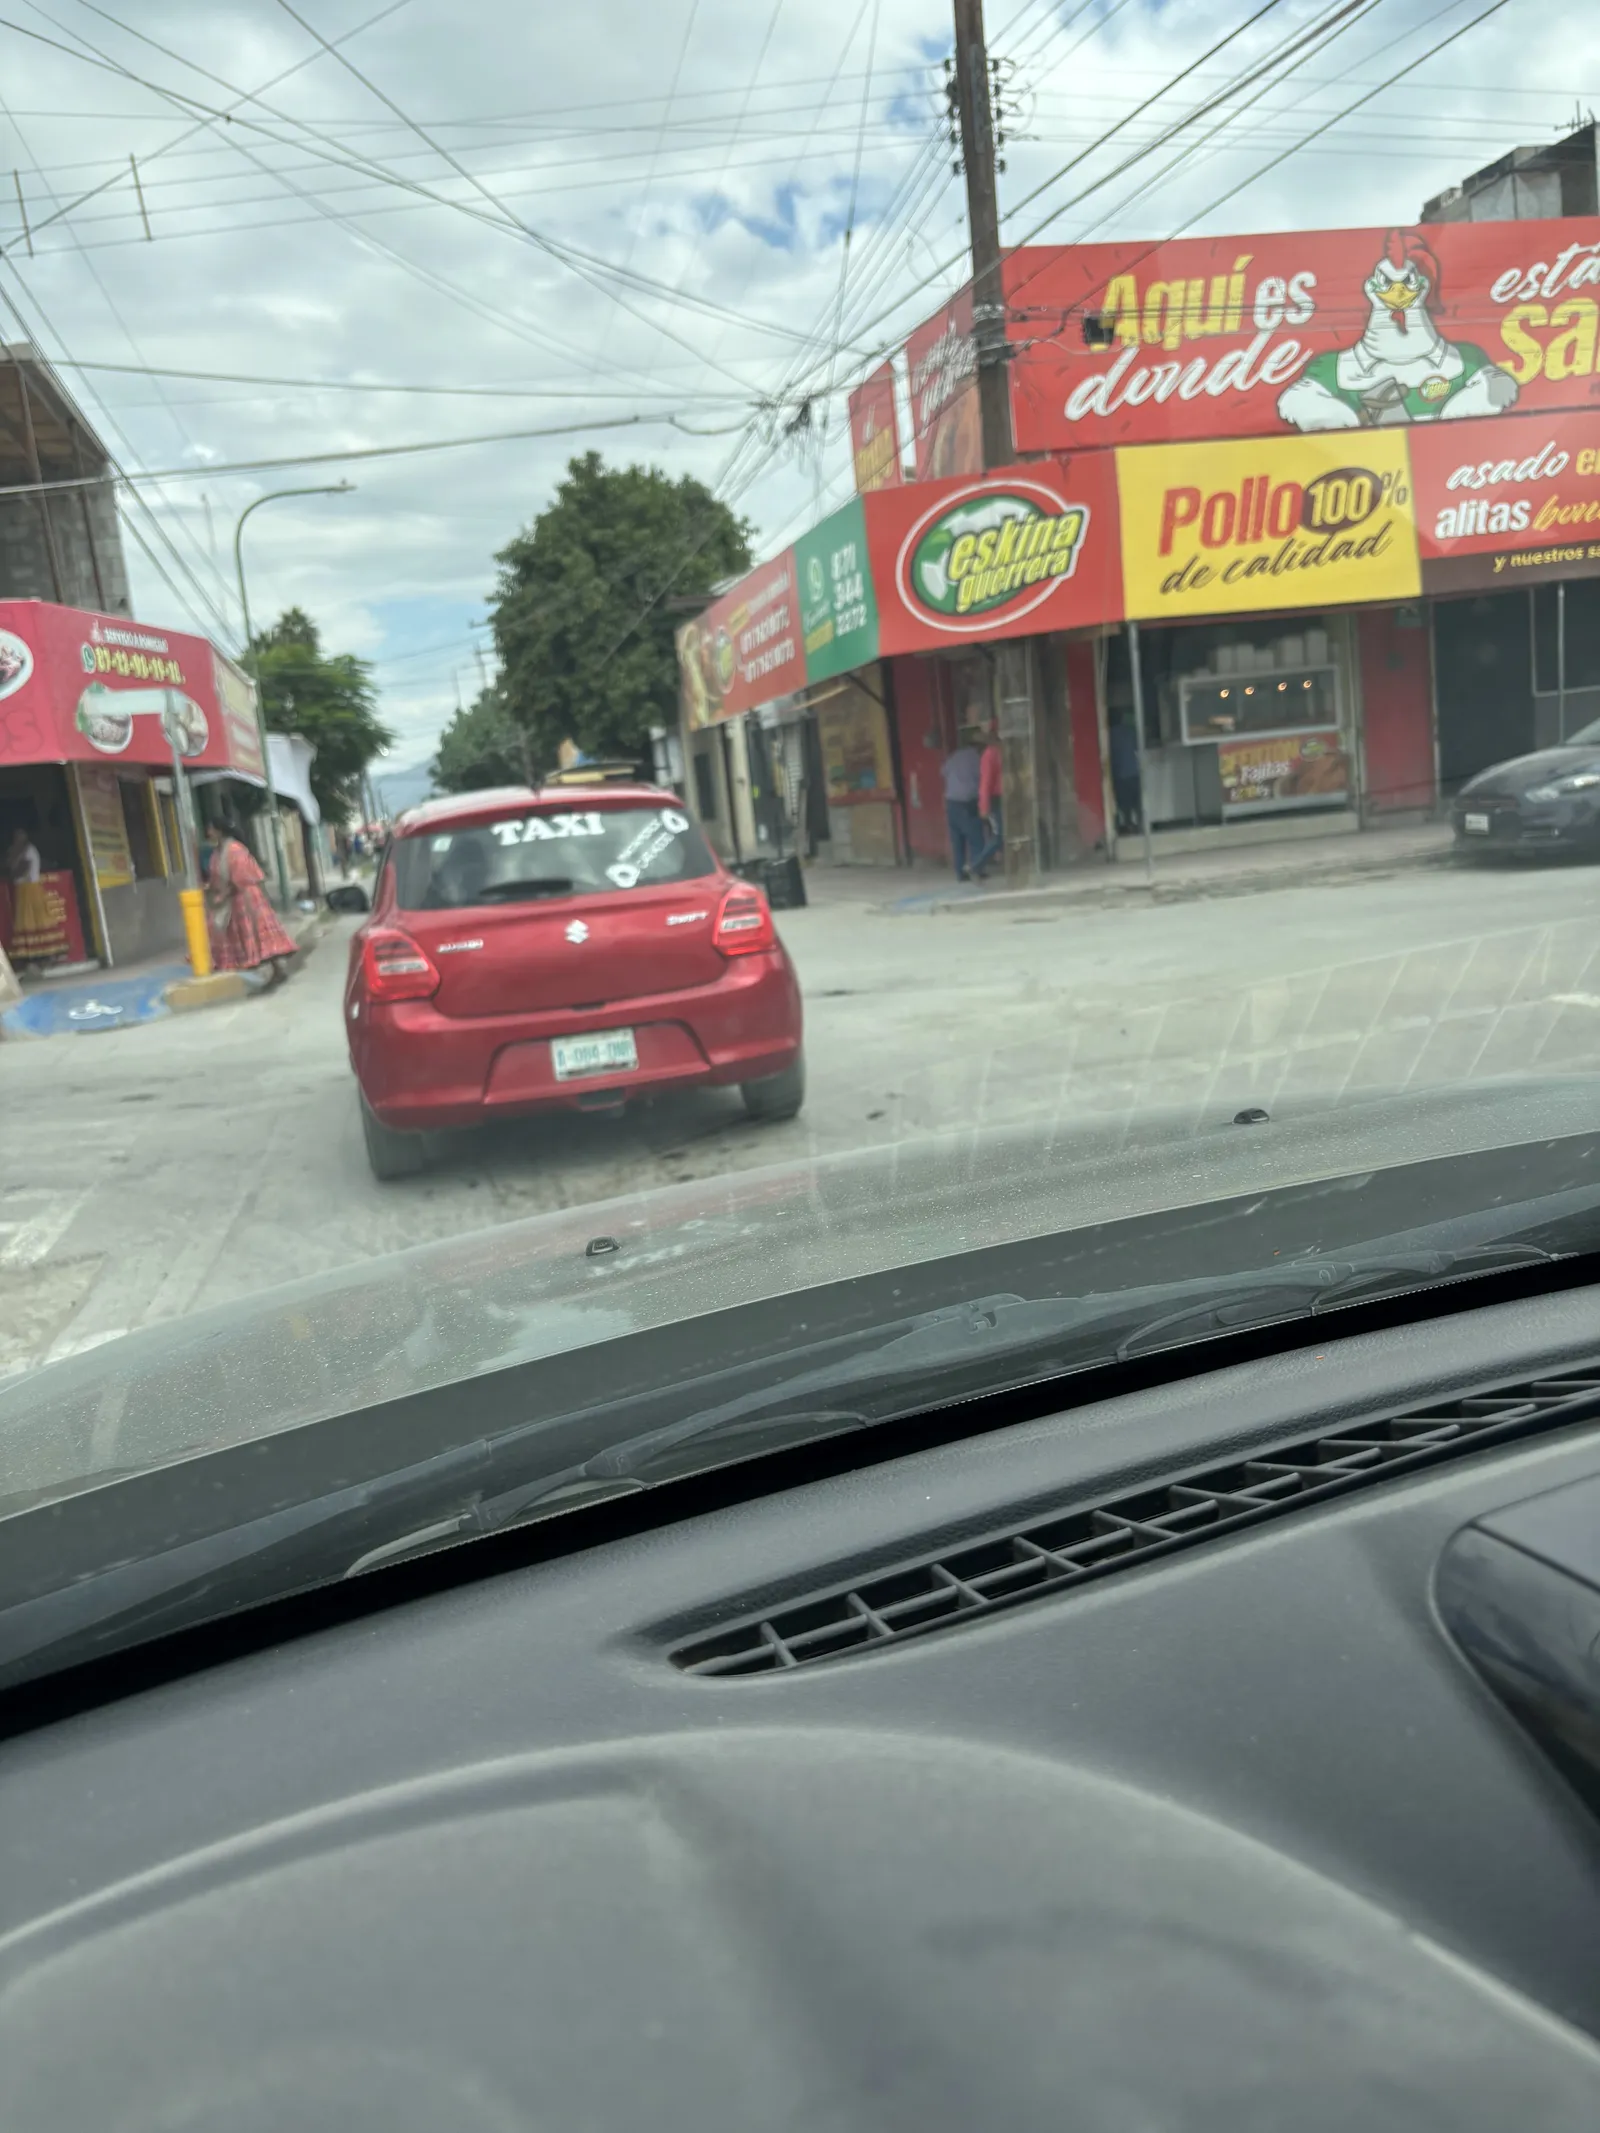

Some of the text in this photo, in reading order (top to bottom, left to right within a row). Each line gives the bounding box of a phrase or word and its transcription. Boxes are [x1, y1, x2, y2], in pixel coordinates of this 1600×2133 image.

[1090, 254, 1317, 352] Aquí es
[1064, 328, 1313, 421] donde
[1497, 297, 1600, 385] sa
[1446, 440, 1570, 490] asado
[948, 513, 1081, 580] eskina
[1158, 475, 1304, 557] Pollo
[1435, 499, 1532, 539] alitas
[956, 548, 1070, 614] guerrera
[1160, 520, 1393, 595] de calidad
[1493, 555, 1507, 573] y
[1511, 546, 1584, 567] nuestros
[490, 811, 606, 846] TAXI
